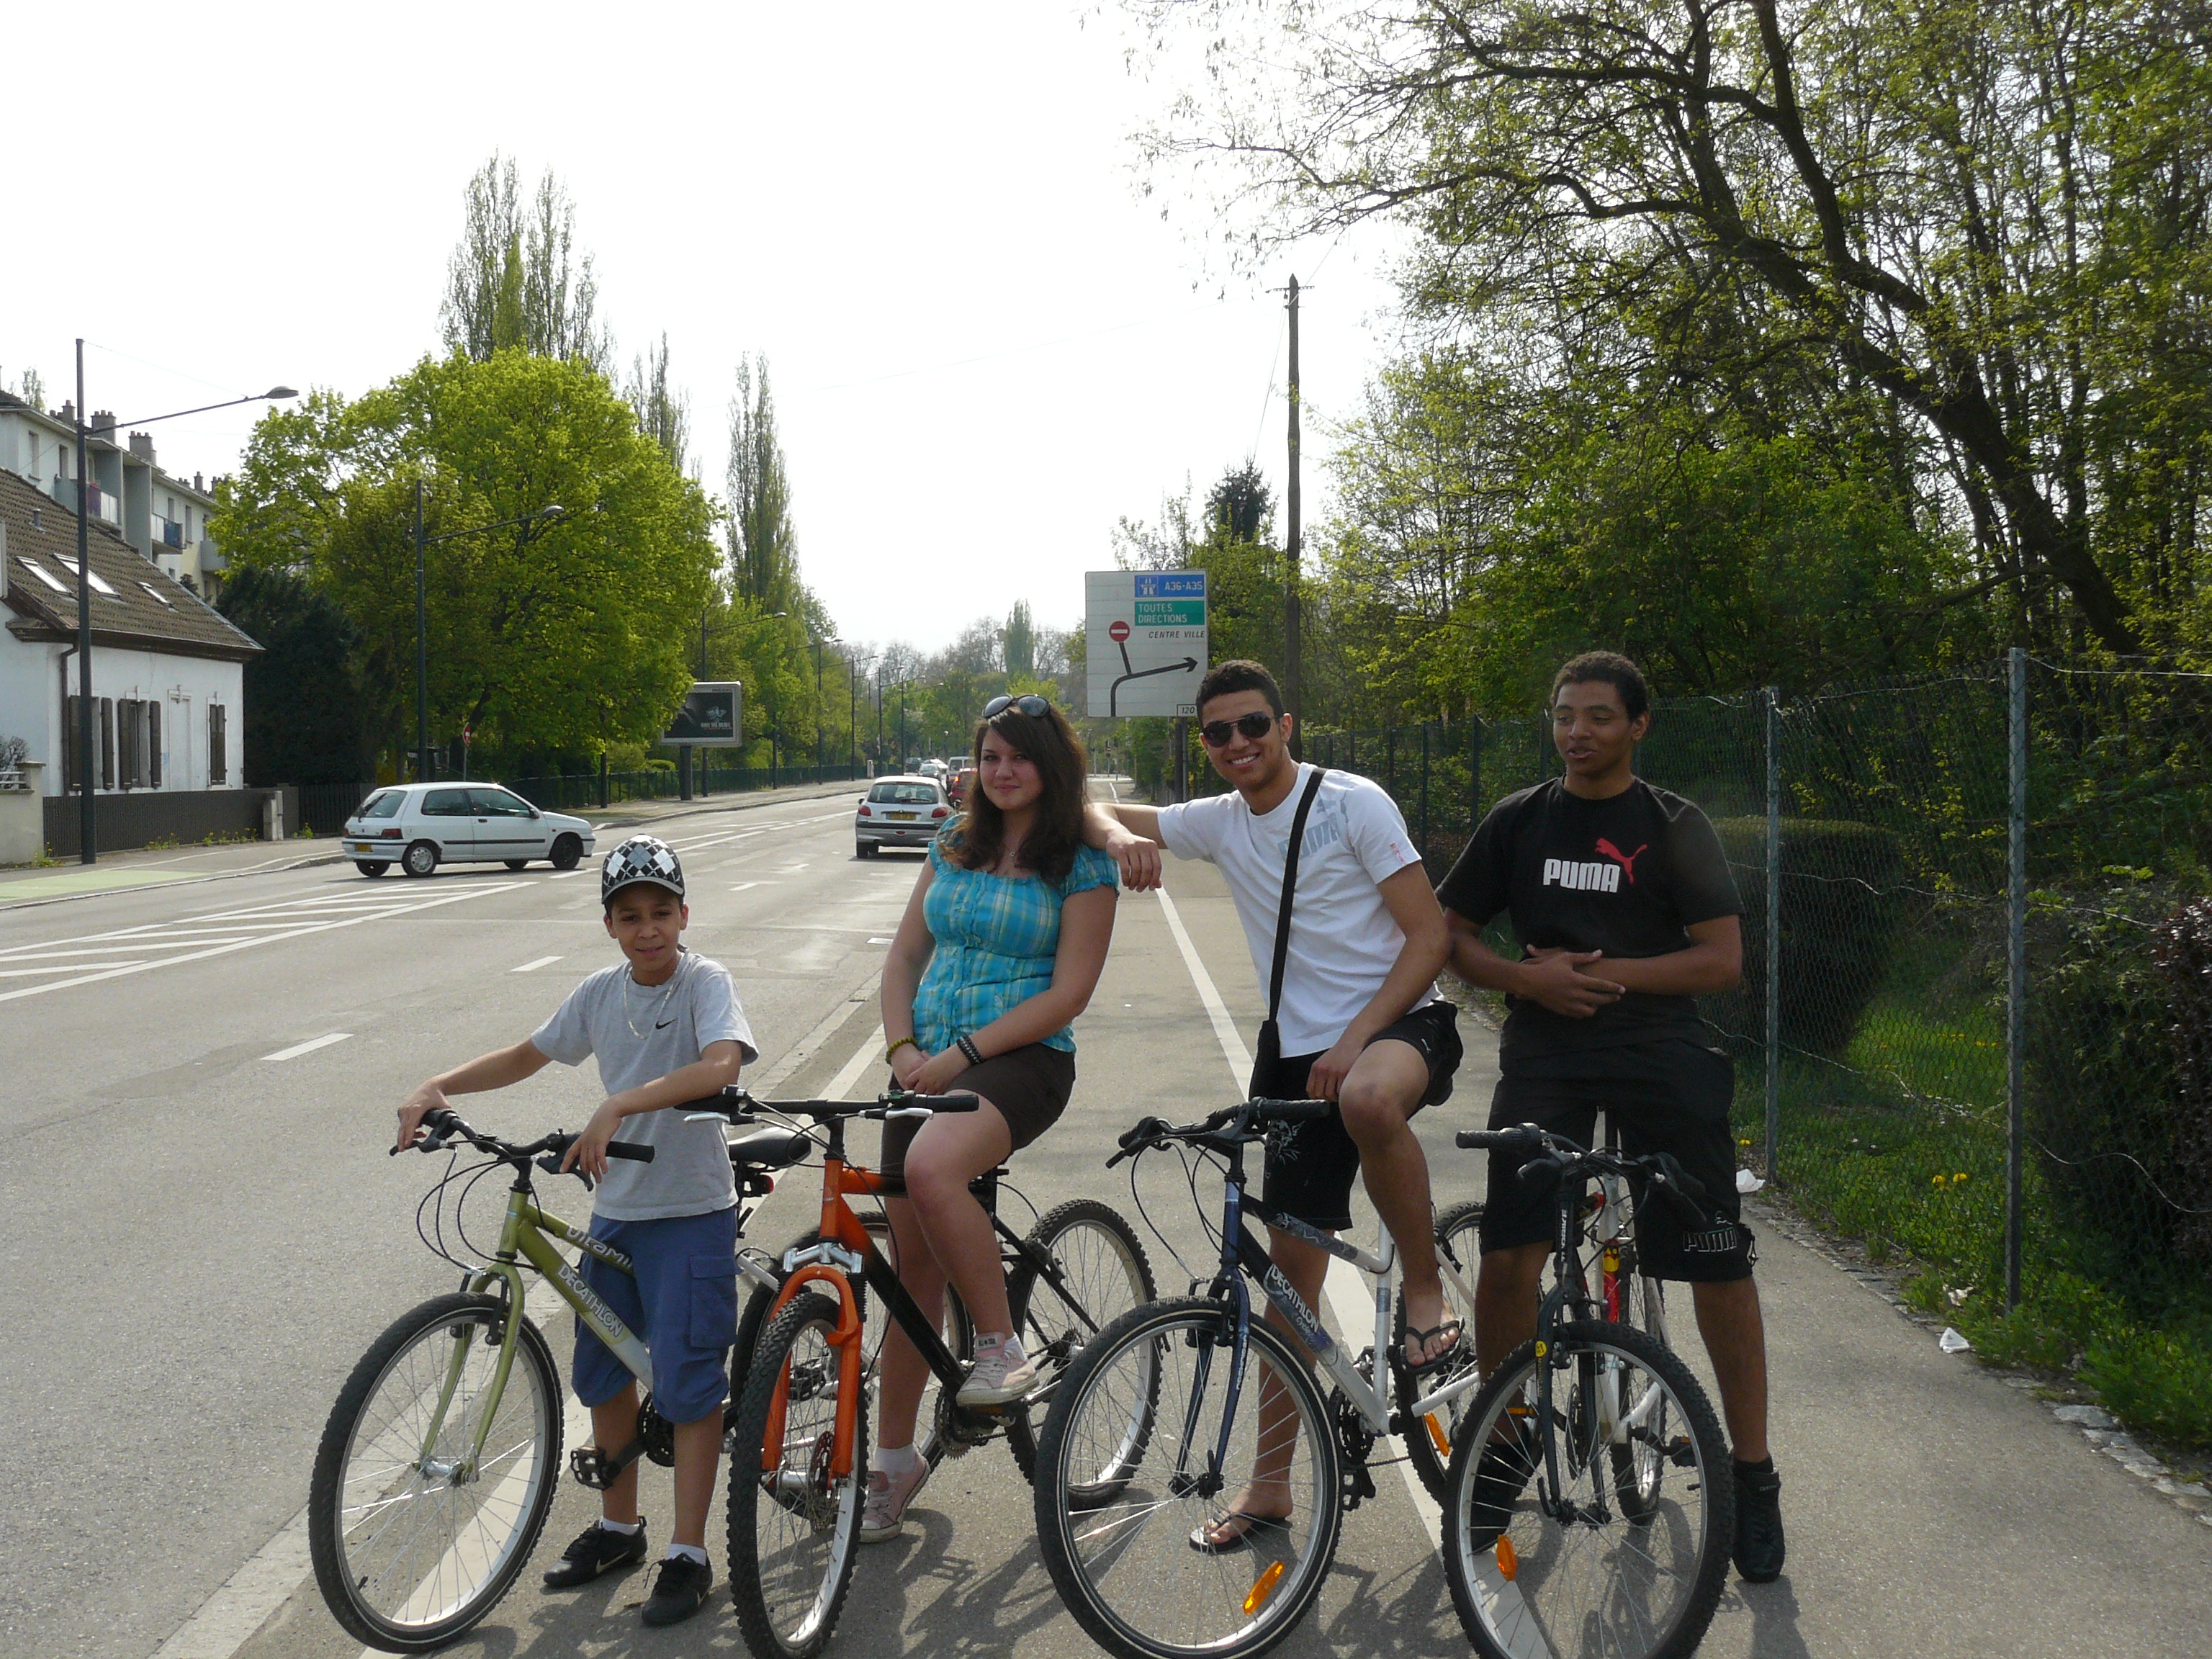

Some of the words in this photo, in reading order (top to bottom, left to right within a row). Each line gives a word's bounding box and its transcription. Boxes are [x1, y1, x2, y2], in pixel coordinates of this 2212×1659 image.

[1164, 581, 1203, 590] A36-A35
[1138, 603, 1172, 613] TOUTES
[1138, 614, 1187, 624] DIRECTIONS
[1148, 630, 1179, 639] CENTRE
[1182, 706, 1195, 714] 120
[1543, 858, 1620, 893] PUMA
[1683, 1227, 1737, 1251] PUMA
[557, 1262, 624, 1338] DECATHLON
[1270, 1263, 1319, 1333] DECATHLON
